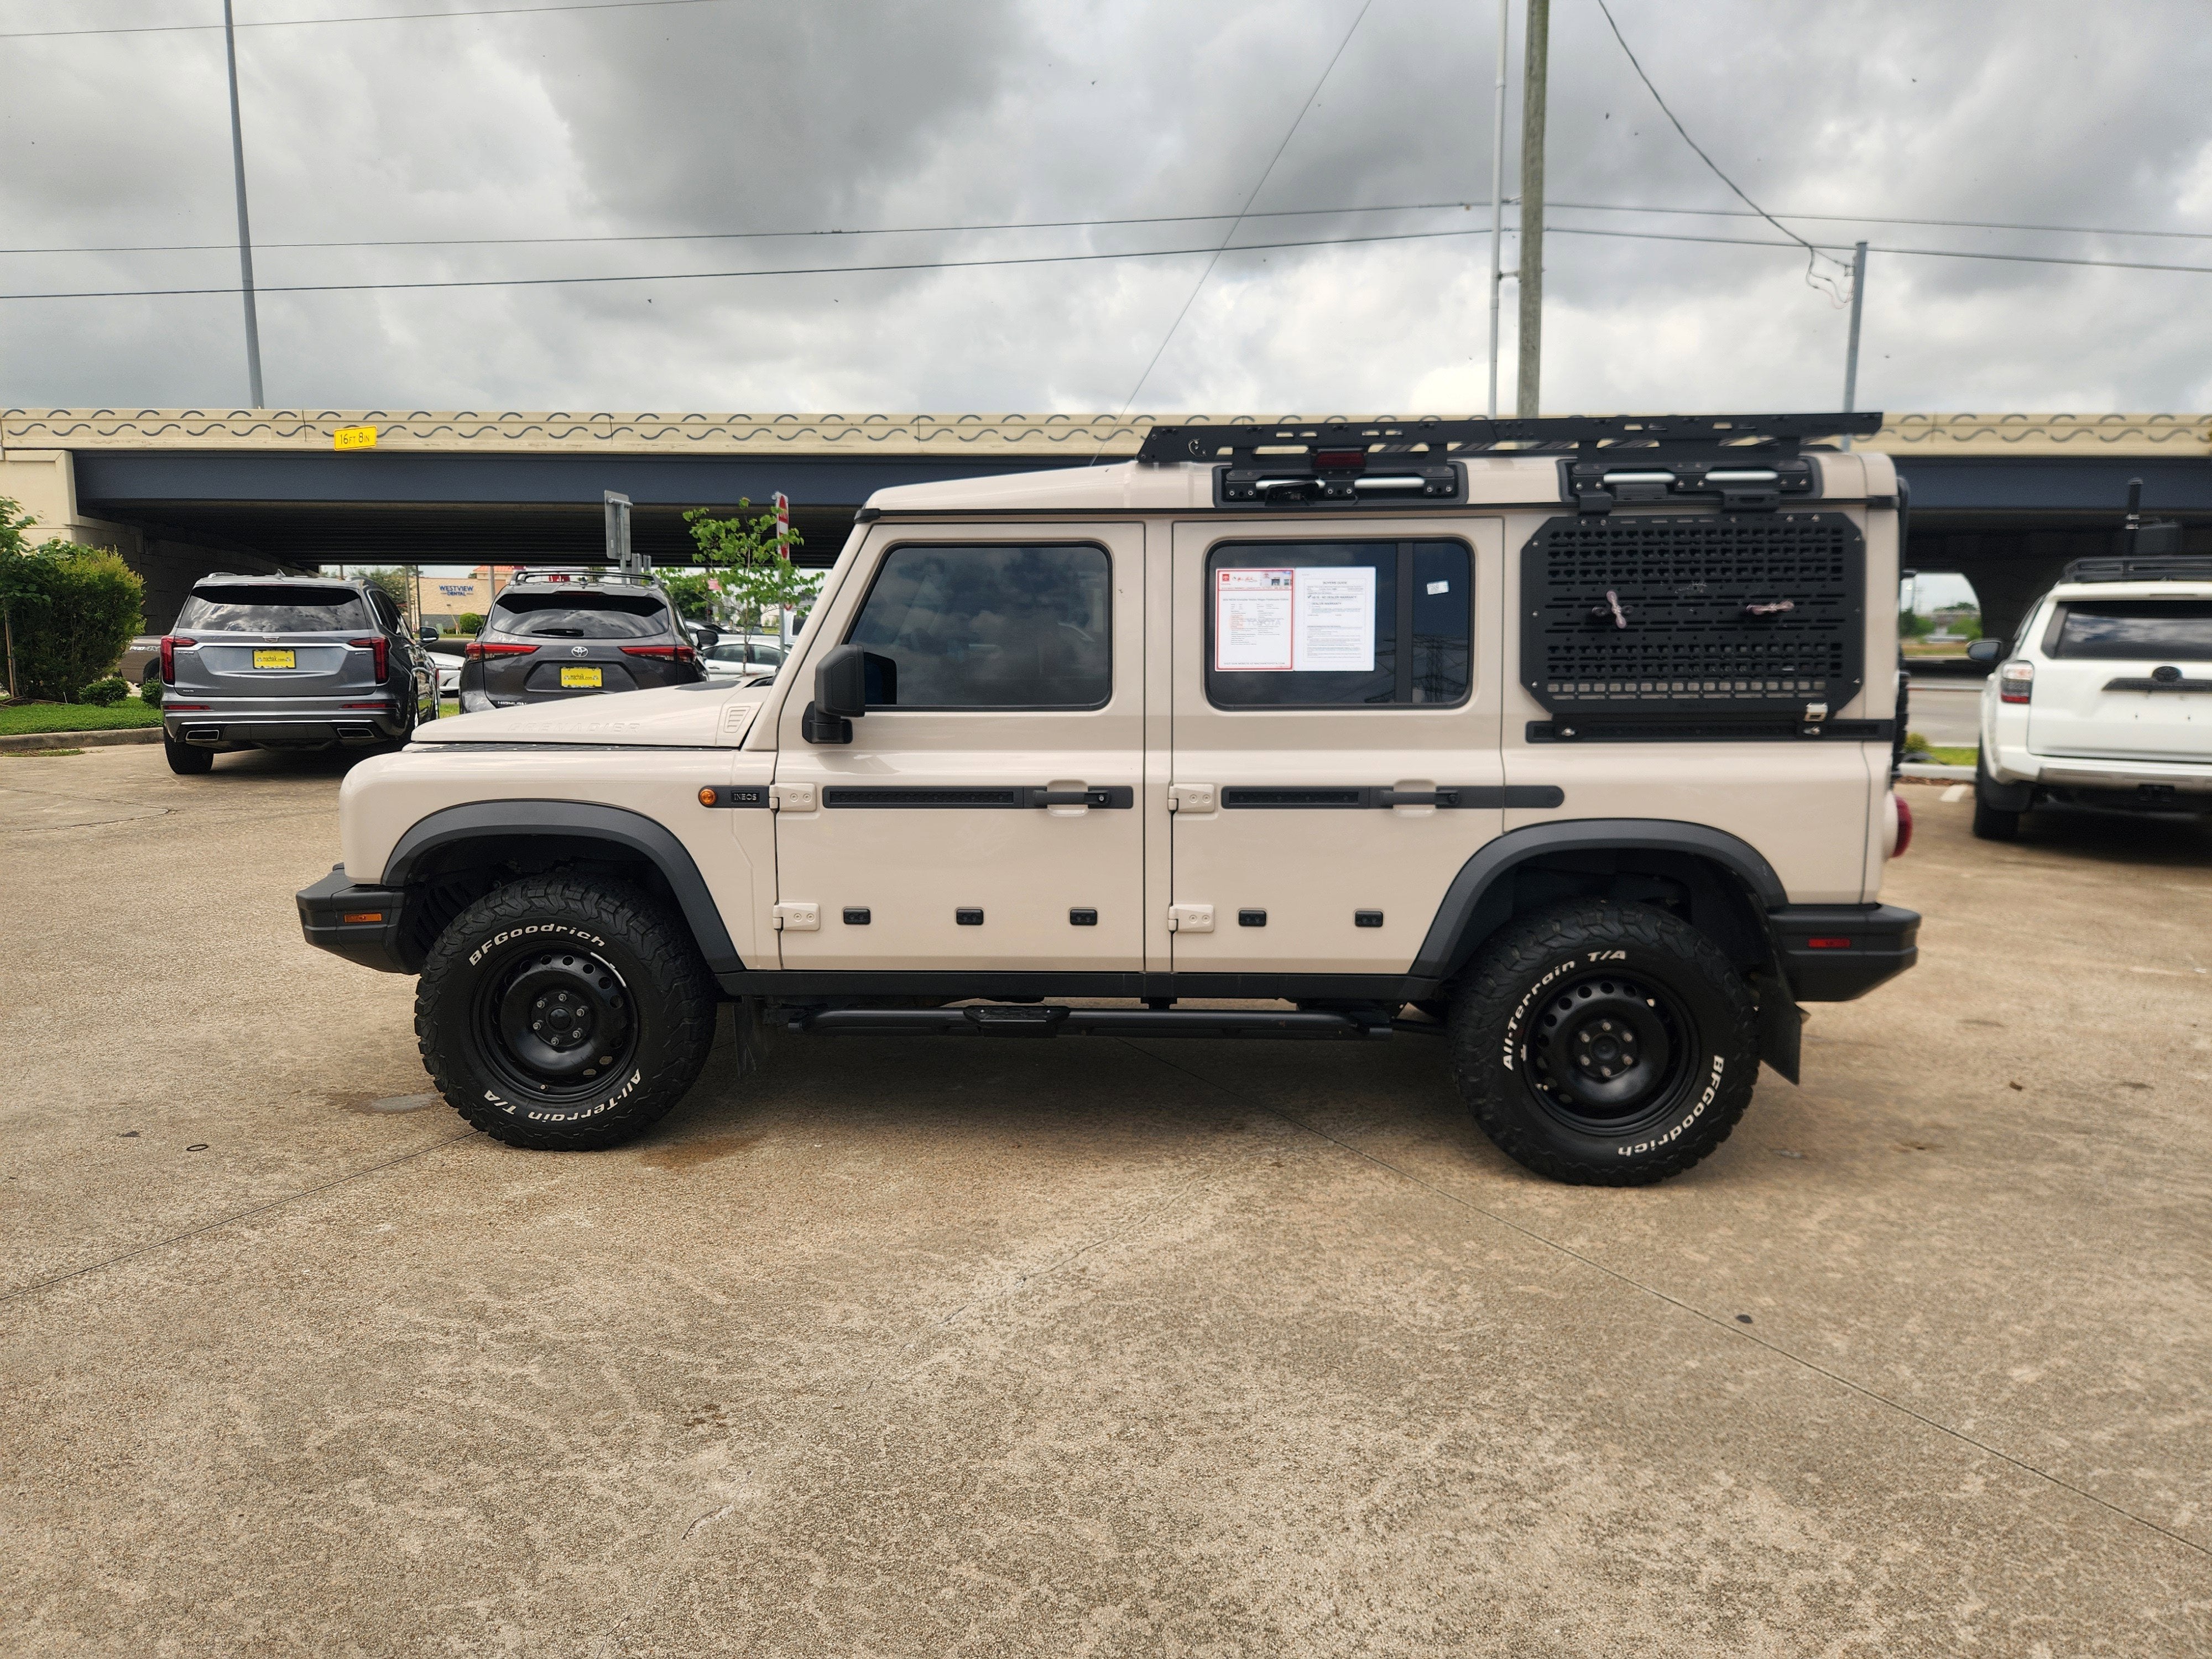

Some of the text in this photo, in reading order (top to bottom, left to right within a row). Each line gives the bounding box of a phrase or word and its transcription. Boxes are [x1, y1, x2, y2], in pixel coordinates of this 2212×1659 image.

[507, 723, 641, 733] GRENADIER
[468, 923, 606, 966] BFGoodrich
[1503, 950, 1626, 1071] All-Terrain T/A
[483, 1068, 641, 1123] All-Terrain T/A
[1618, 1055, 1725, 1157] BFGoodrich
